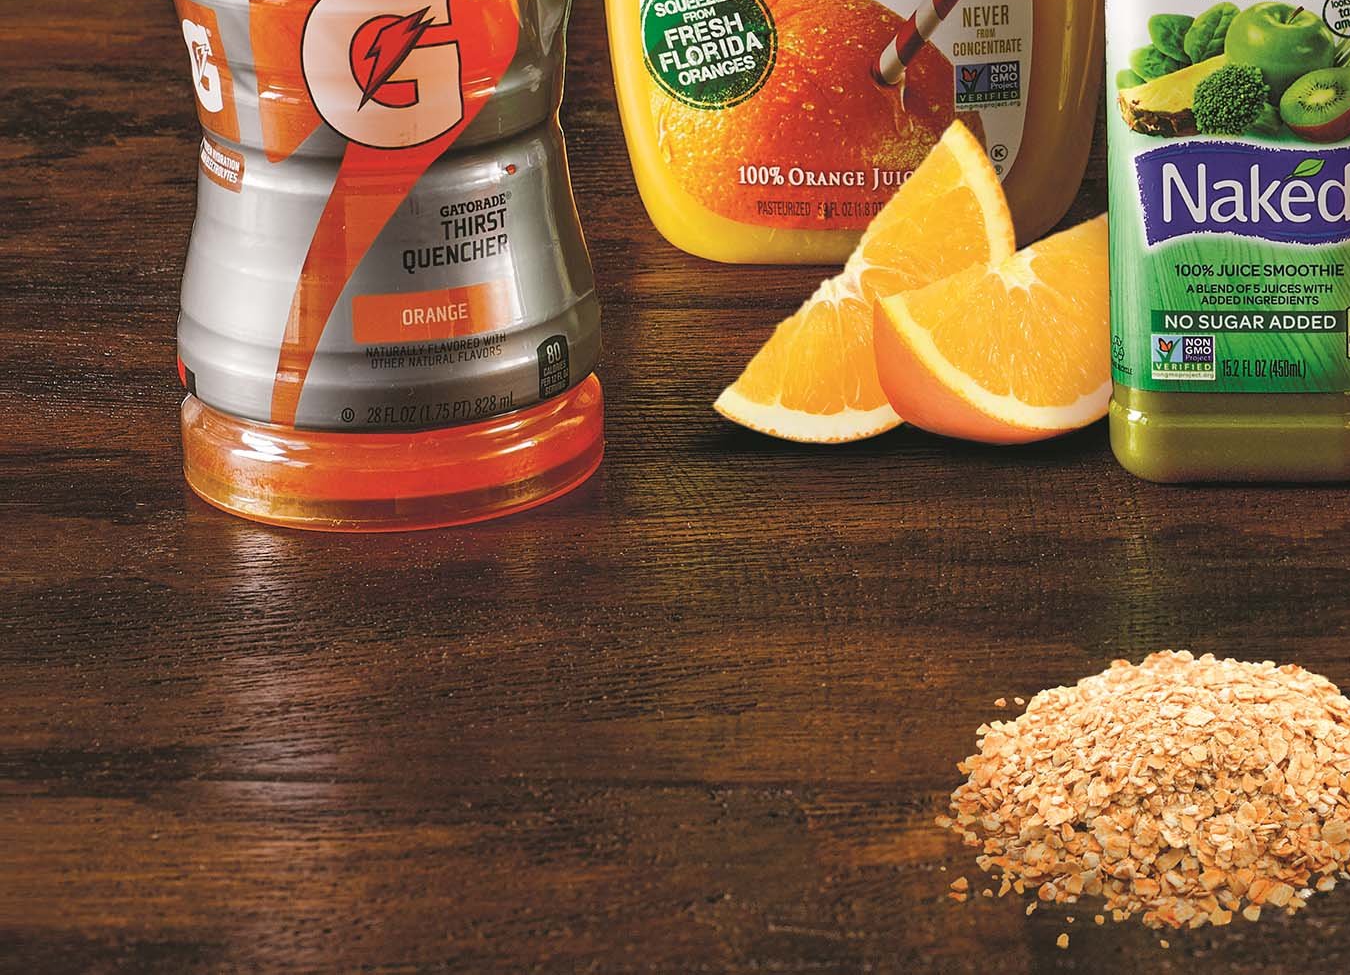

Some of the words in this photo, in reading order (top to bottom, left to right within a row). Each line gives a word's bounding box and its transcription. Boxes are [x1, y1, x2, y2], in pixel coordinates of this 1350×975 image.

[682, 6, 717, 24] FROM
[962, 4, 1009, 28] NEVER
[663, 12, 745, 50] FRESH
[976, 28, 996, 39] FROM
[658, 31, 764, 73] FLORIDA
[952, 38, 1023, 57] CONCENTRATE
[678, 55, 756, 86] ORANGES
[990, 63, 1017, 74] NON
[990, 73, 1018, 83] GMO
[959, 90, 1018, 102] VERIFIED
[737, 165, 785, 186] 100%
[788, 167, 865, 187] ORANGE
[440, 192, 507, 218] GATORADE
[757, 200, 811, 217] PASTEURIZED
[441, 208, 508, 240] THIRST
[402, 233, 509, 274] QUENCHER
[1174, 264, 1215, 277] 100%
[1217, 264, 1261, 277] JUICE
[1263, 263, 1345, 277] SMOOTHIE
[1196, 284, 1235, 294] BLEND
[1237, 284, 1252, 294] OF
[1261, 284, 1301, 294] JUICES
[1303, 284, 1333, 294] WITH
[1201, 295, 1241, 306] ADDED
[1243, 295, 1320, 306] INGREDIENTS
[402, 302, 469, 326] ORANGE
[1165, 315, 1194, 330] NO
[1198, 315, 1264, 330] SUGAR
[1269, 314, 1337, 330] ADDED
[1185, 338, 1211, 347] NON
[1185, 346, 1212, 355] GMO
[371, 357, 406, 369] OTHER
[409, 354, 456, 367] NATURAL
[458, 345, 502, 362] FLAVORS
[546, 341, 561, 364] 80
[1155, 363, 1212, 371] VERIFIED
[1222, 359, 1239, 377] 15.2
[1242, 359, 1253, 377] FL
[1255, 359, 1267, 377] OZ
[367, 407, 381, 424] 28
[474, 395, 497, 415] 828
